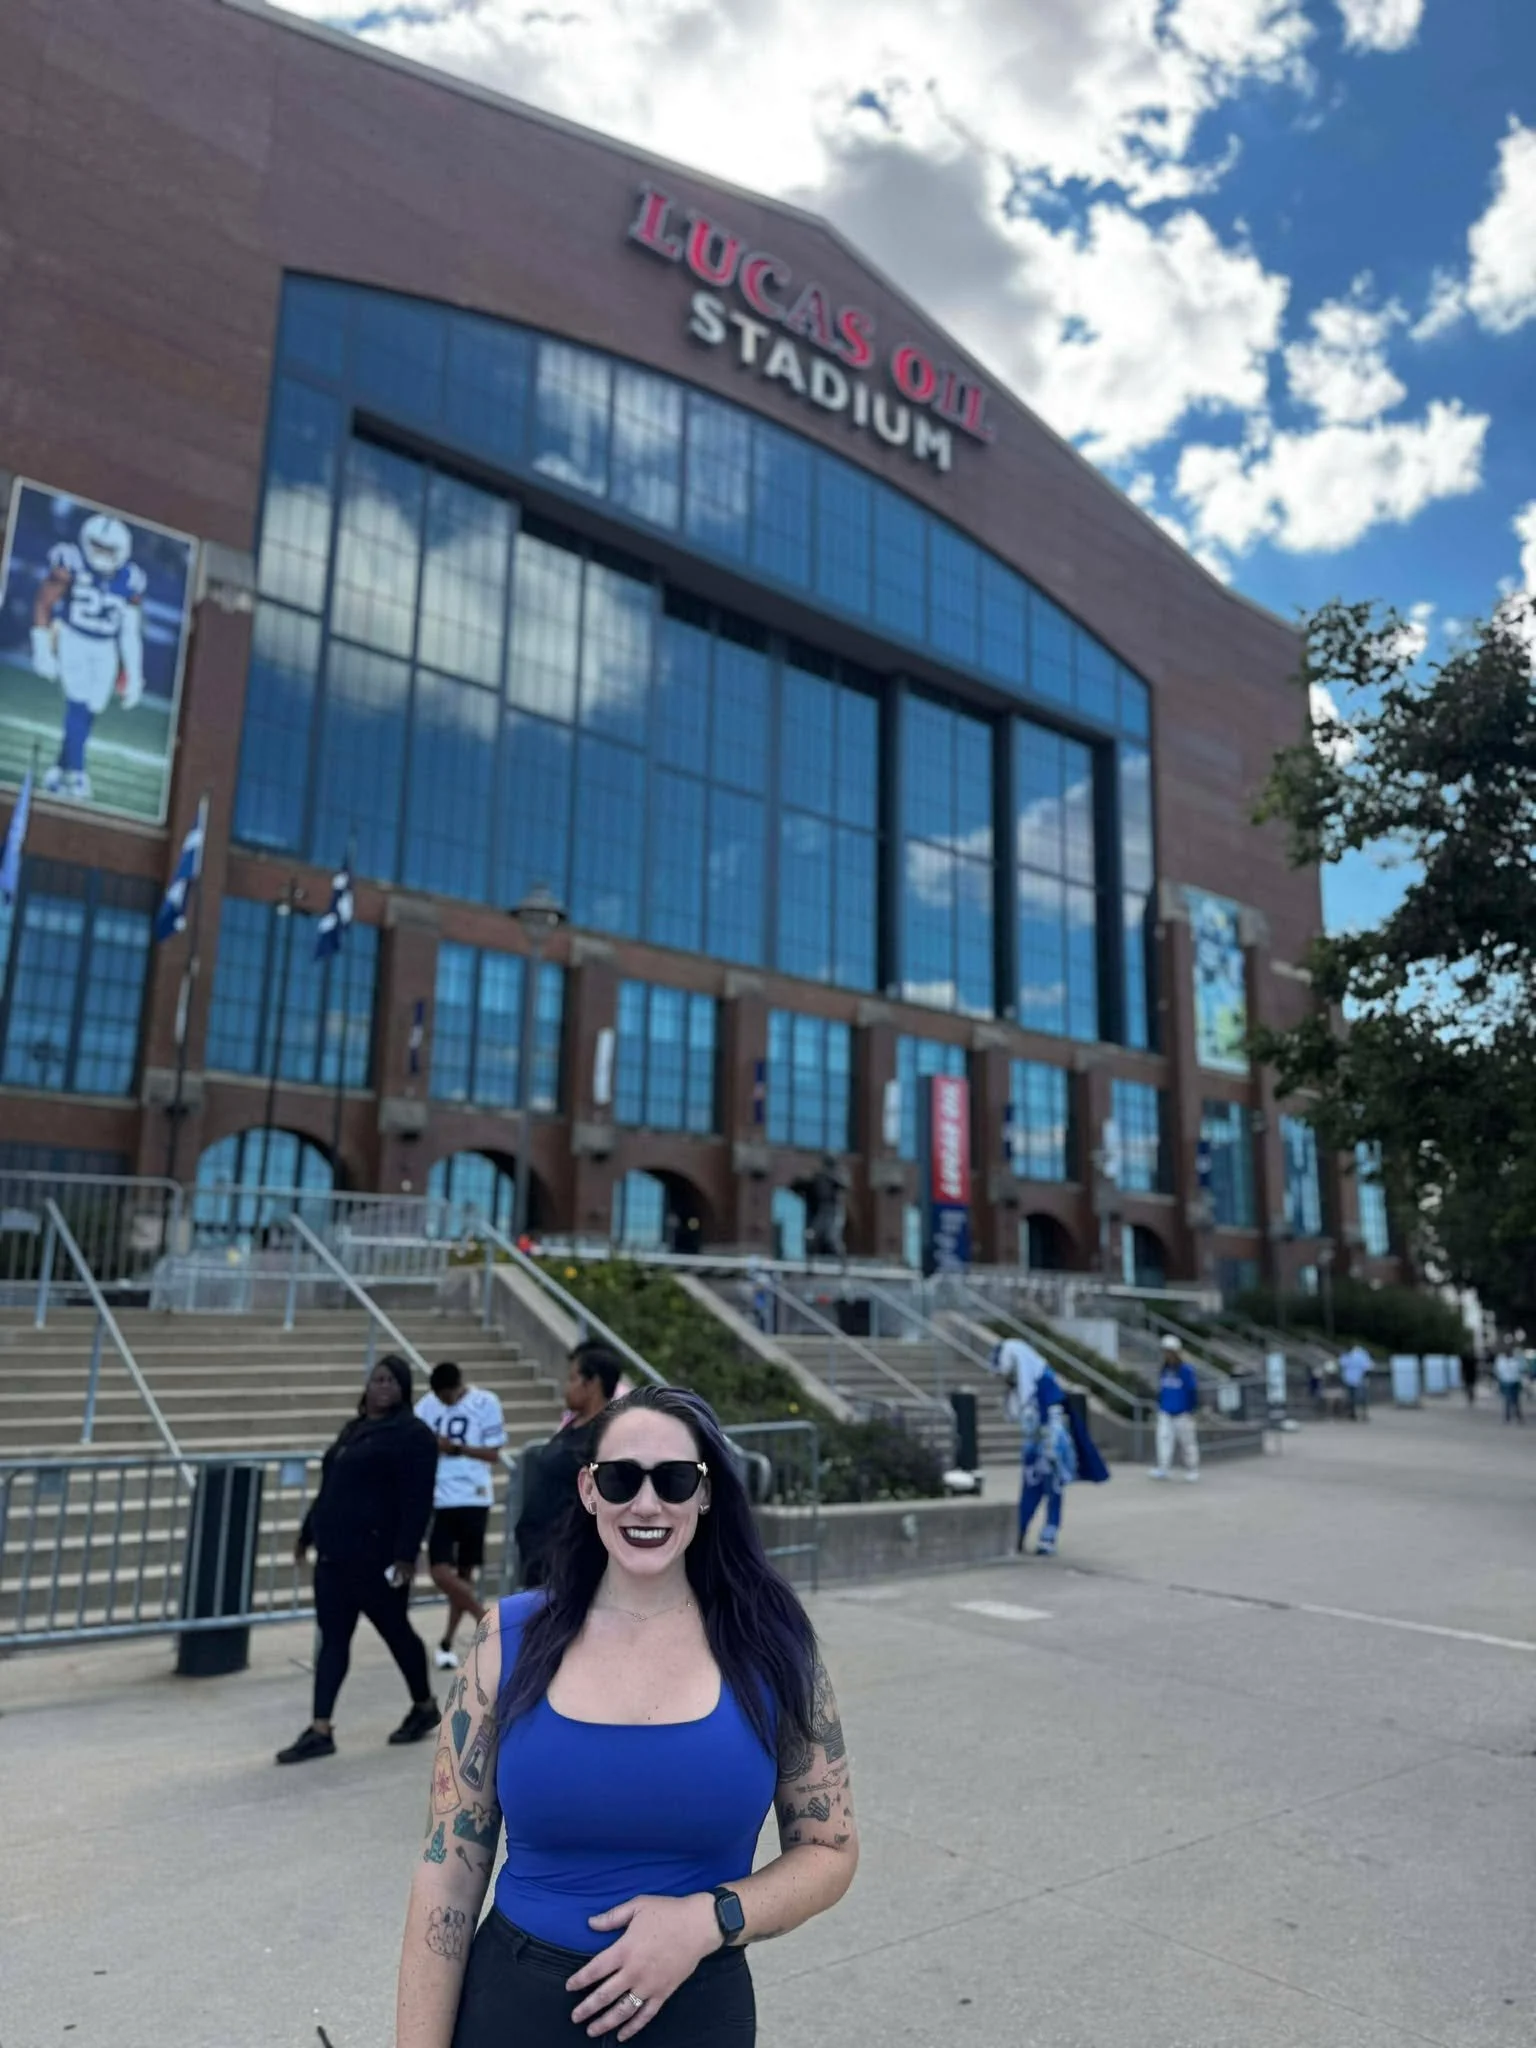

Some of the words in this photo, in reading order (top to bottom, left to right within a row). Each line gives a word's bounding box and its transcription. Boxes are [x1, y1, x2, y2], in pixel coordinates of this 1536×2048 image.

[629, 182, 873, 368] LUCAS
[891, 344, 995, 442] OIL
[689, 291, 952, 471] STADIUM
[434, 1416, 468, 1446] 18
